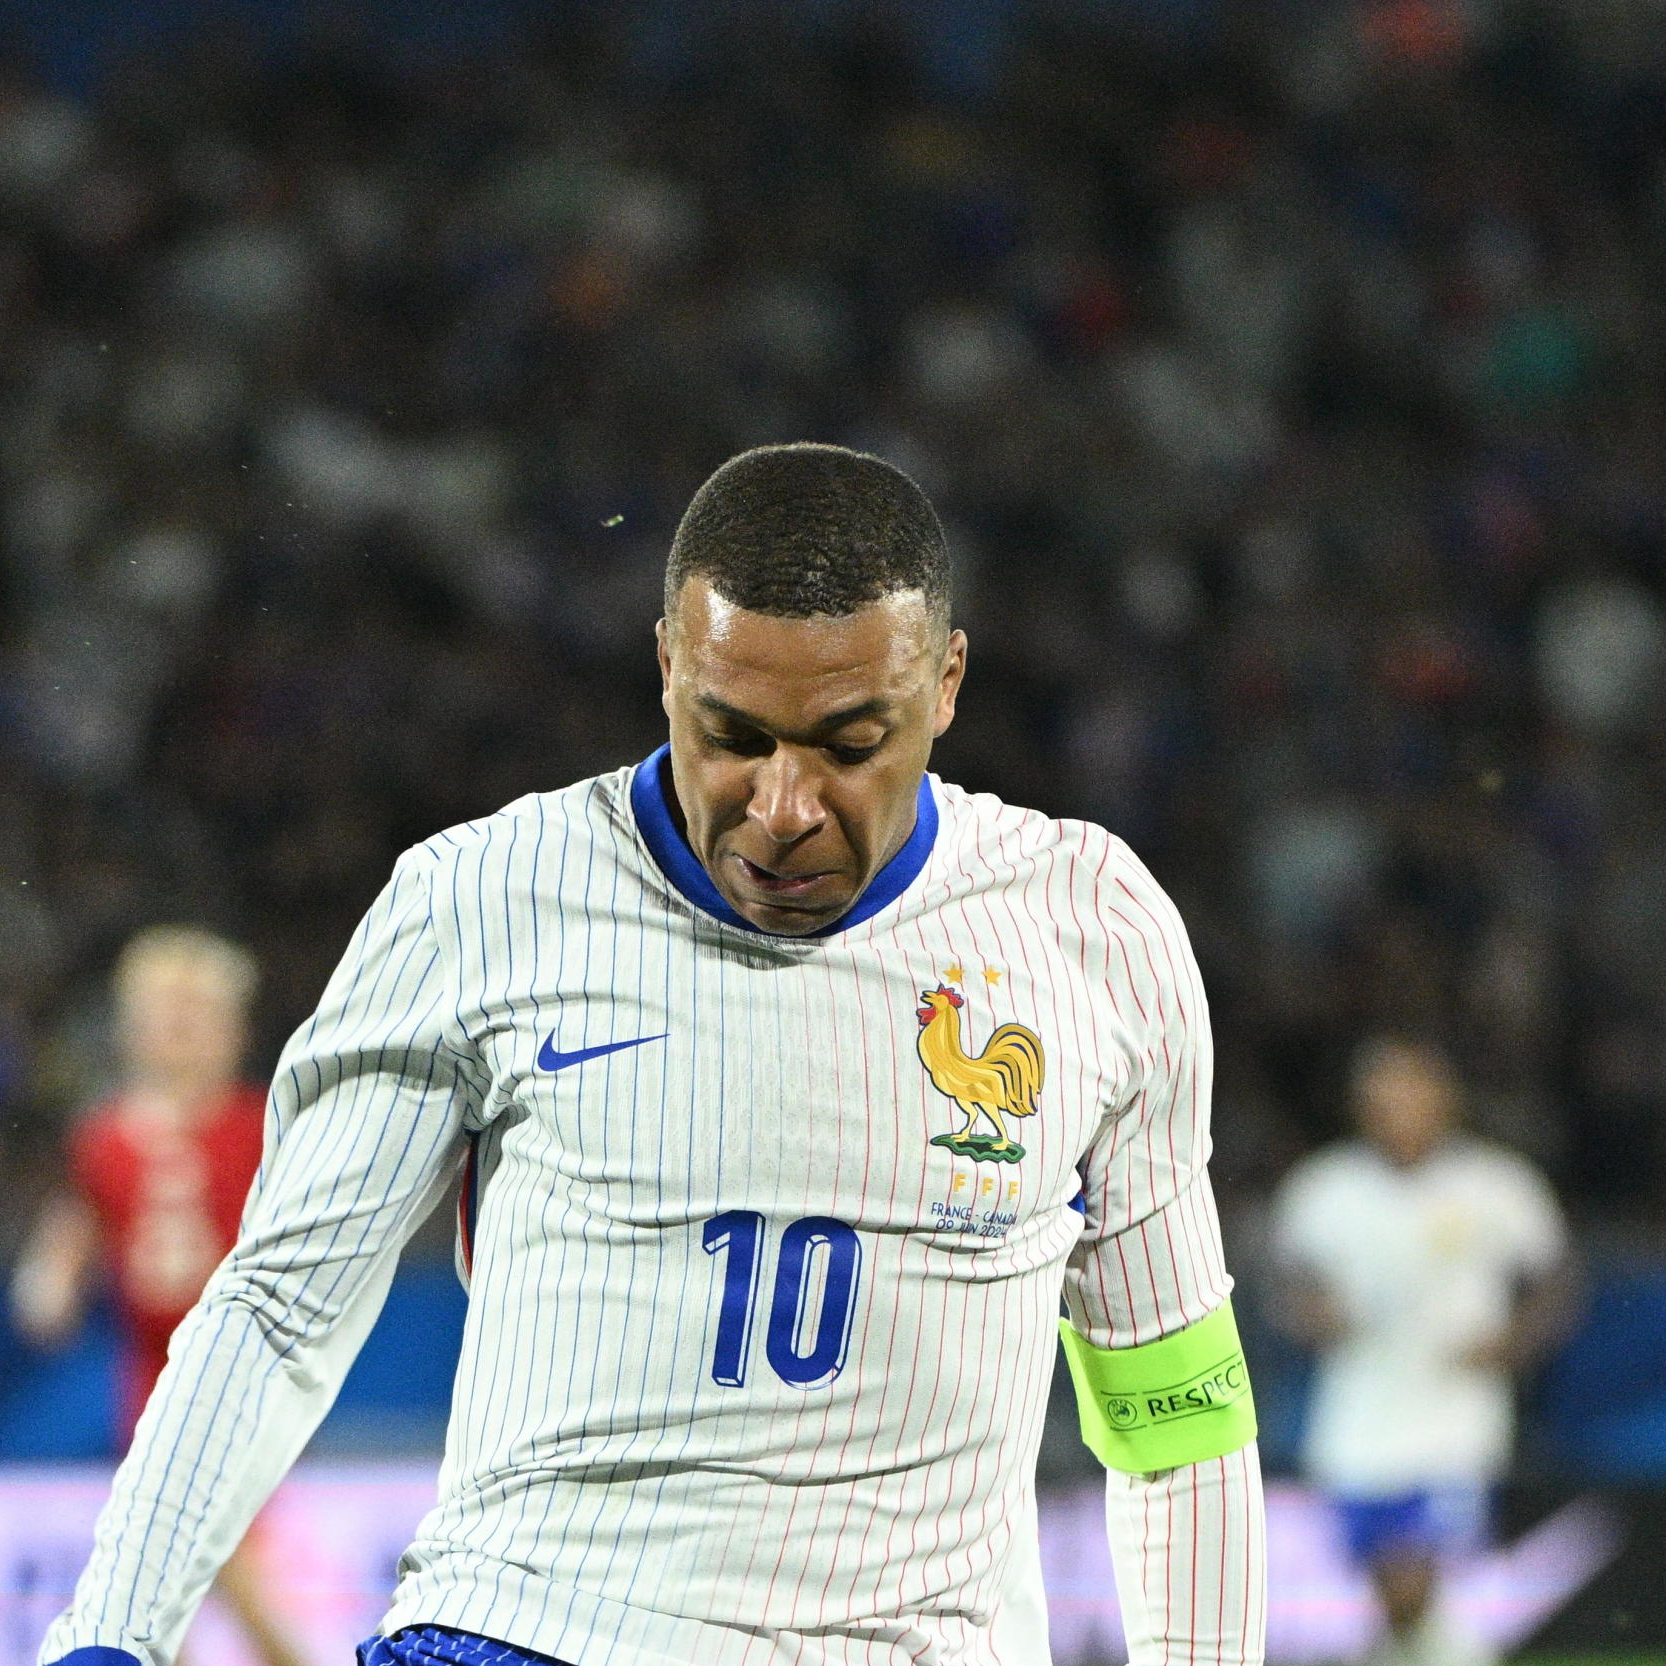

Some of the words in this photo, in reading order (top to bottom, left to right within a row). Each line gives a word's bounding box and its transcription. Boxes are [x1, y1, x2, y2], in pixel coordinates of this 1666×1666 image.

[930, 1202, 973, 1220] FRANCE
[935, 1218, 954, 1230] 09
[956, 1220, 979, 1235] JUIN
[979, 1224, 1007, 1238] 2024
[702, 1209, 863, 1391] 10
[1146, 1358, 1247, 1417] RESPECT
